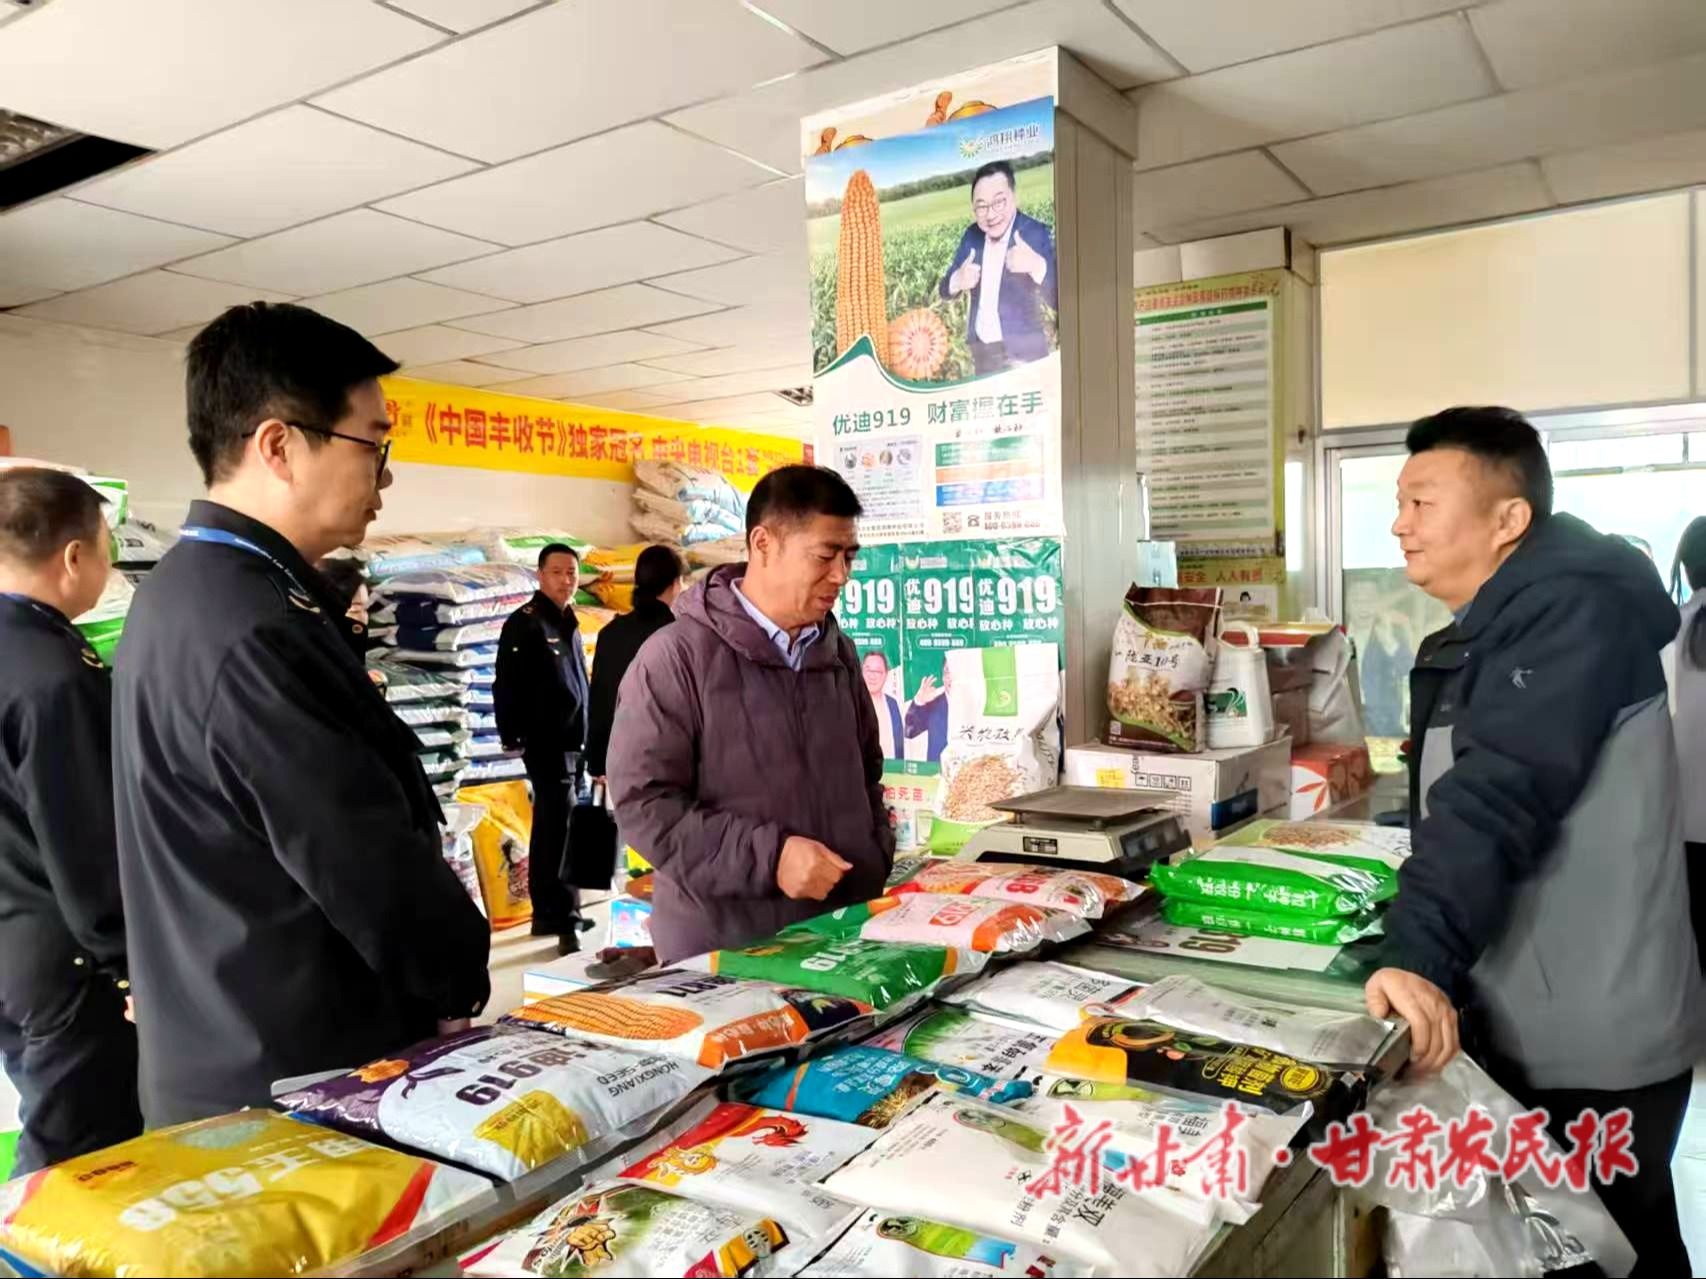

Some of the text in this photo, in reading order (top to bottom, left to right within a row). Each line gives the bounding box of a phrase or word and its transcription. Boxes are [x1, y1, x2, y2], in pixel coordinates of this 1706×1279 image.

[832, 407, 912, 436] 优迪919
[844, 577, 895, 615] 919
[923, 576, 973, 615] 919
[997, 575, 1057, 616] 919
[607, 1060, 680, 1098] HONGXIANG
